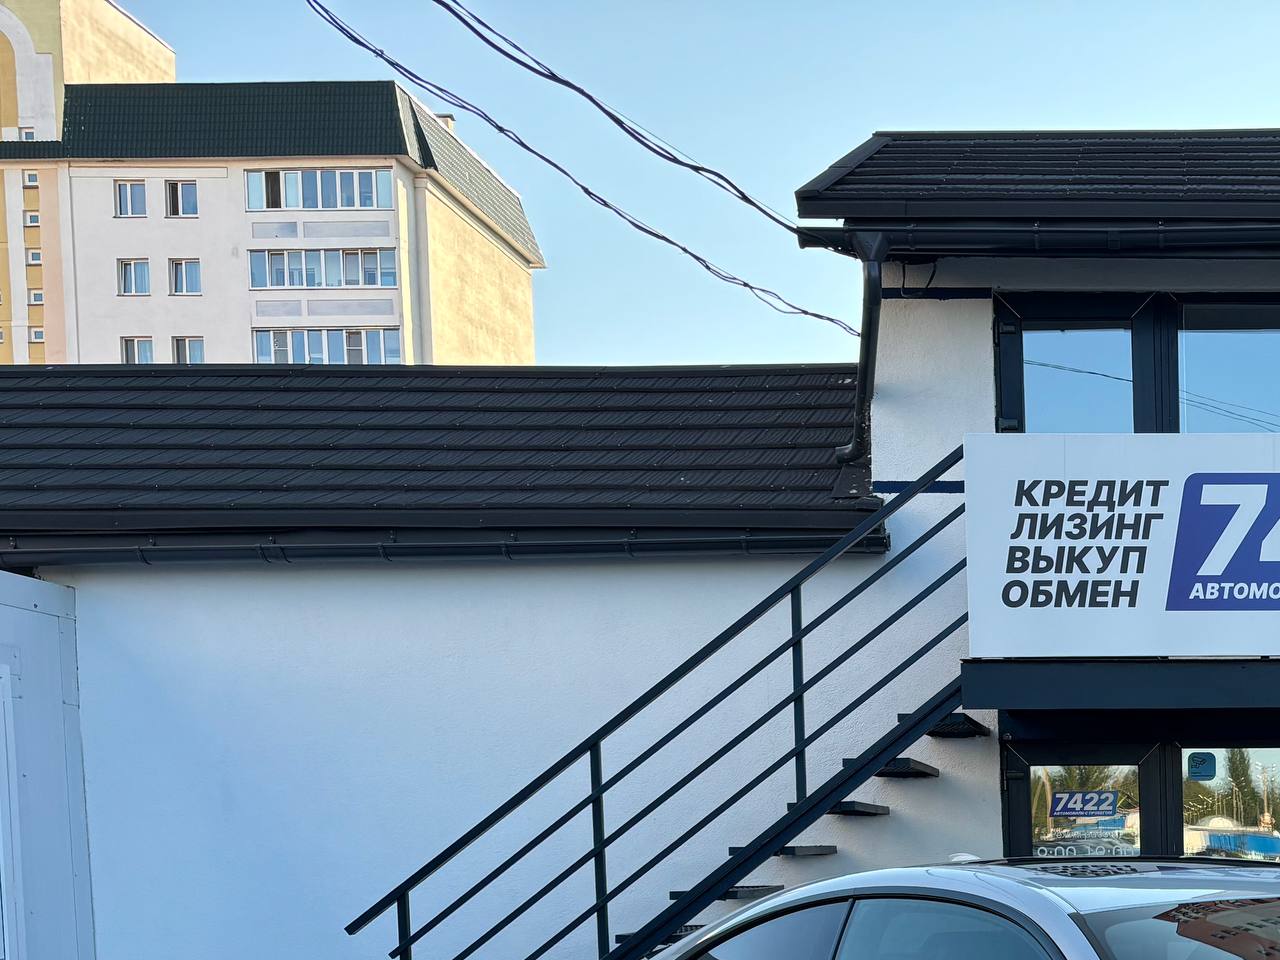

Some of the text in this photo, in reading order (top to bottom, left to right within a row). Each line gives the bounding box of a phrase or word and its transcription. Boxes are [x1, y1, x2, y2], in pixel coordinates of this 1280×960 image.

[1014, 479, 1170, 513] КРЕДИТ
[1009, 512, 1164, 540] ЛИЗИНГ
[1005, 545, 1148, 574] ВЫКУП
[1001, 579, 1140, 608] ОБМЕН
[1055, 792, 1115, 812] 7422
